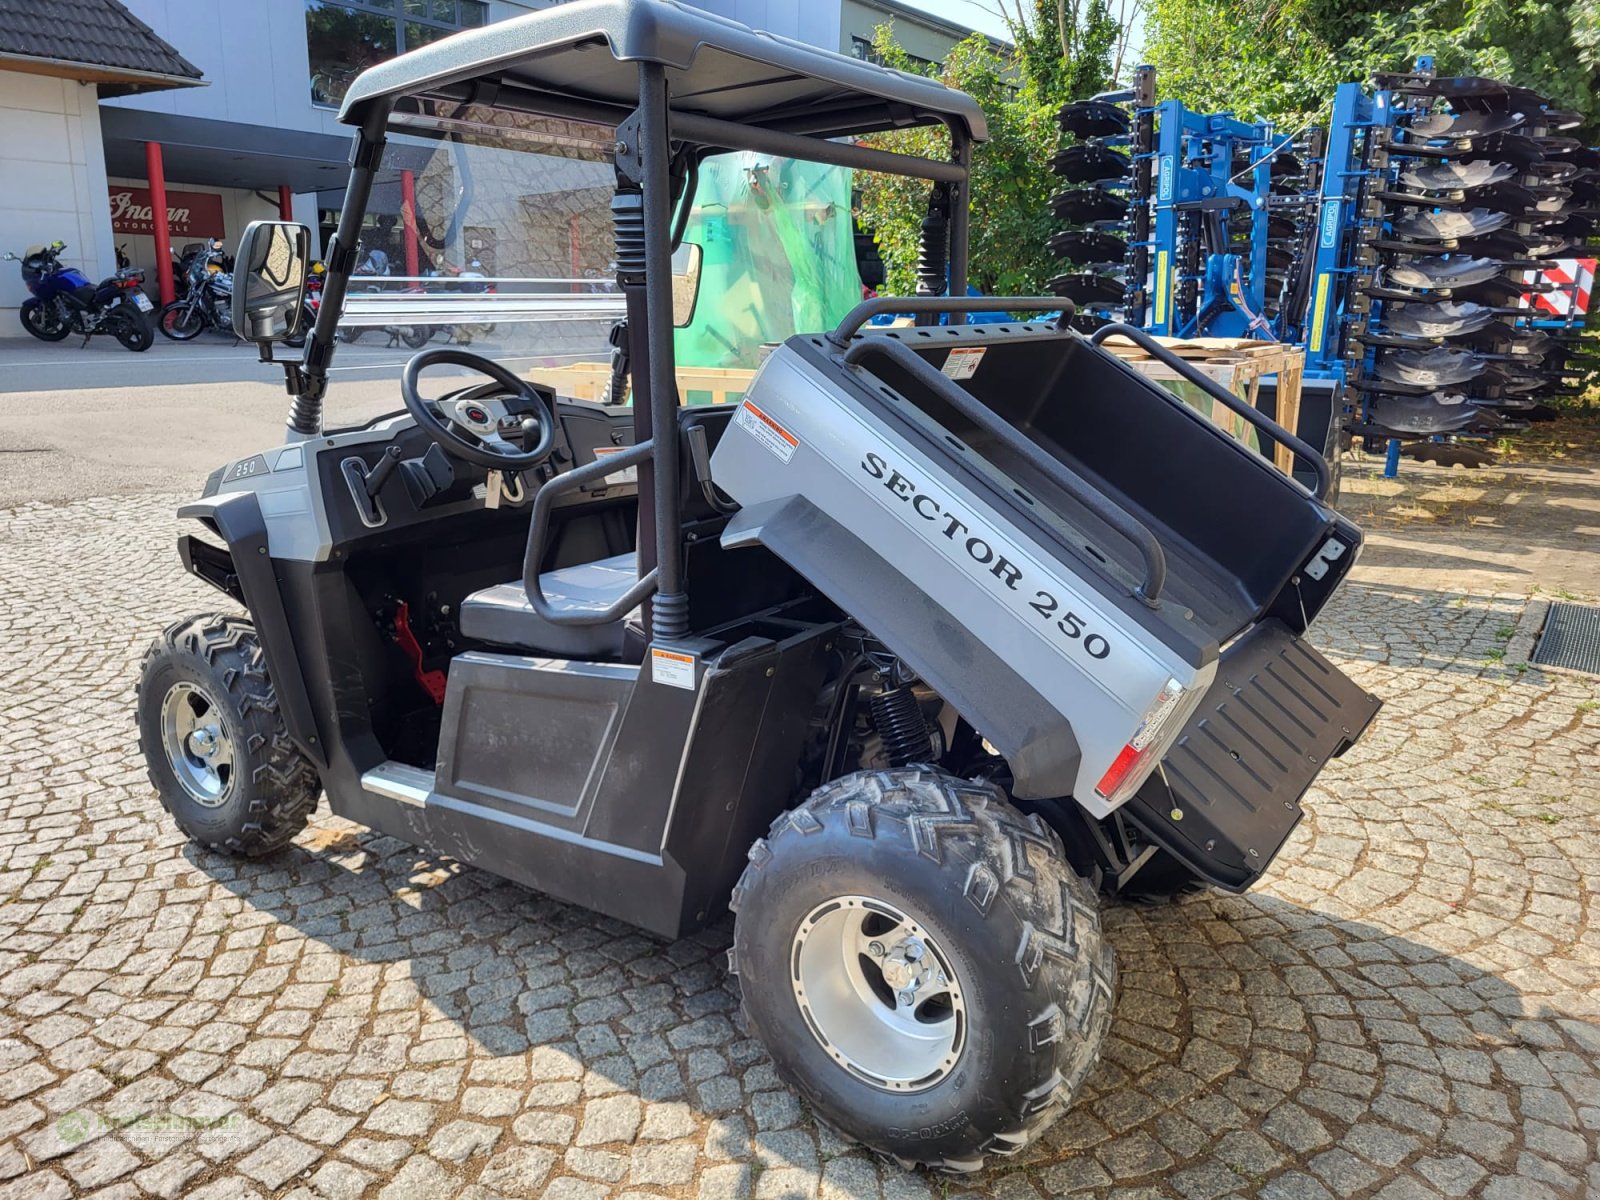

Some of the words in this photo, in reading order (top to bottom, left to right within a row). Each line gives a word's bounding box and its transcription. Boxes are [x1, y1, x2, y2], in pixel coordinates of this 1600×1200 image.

[110, 192, 190, 222] Indan
[1325, 203, 1336, 237] AGRIPOL
[112, 221, 189, 233] OTORCCLE
[236, 461, 255, 477] 250
[861, 452, 1023, 591] SECTOR
[1028, 591, 1111, 660] 250
